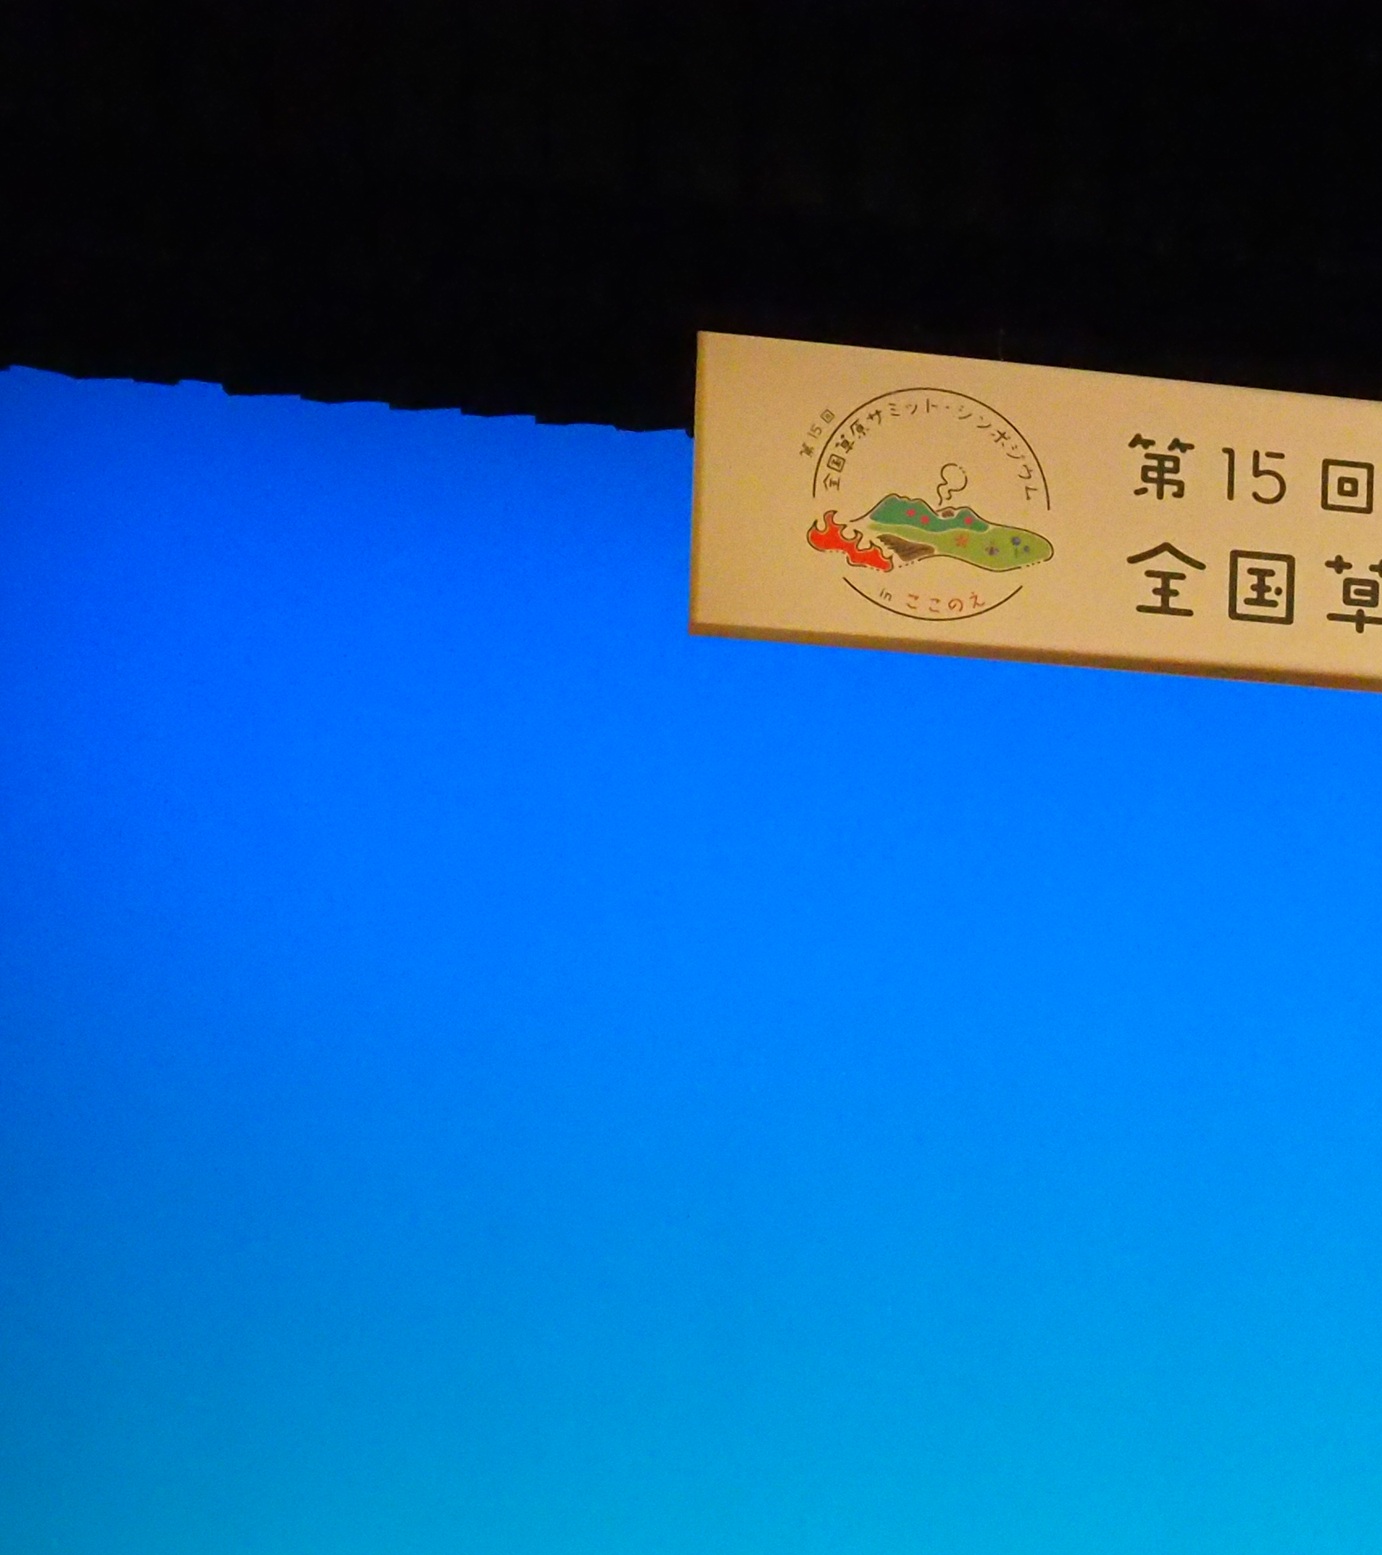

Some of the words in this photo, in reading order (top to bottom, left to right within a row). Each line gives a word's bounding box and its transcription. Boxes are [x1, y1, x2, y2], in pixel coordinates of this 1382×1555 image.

[1128, 433, 1374, 514] 第15回
[905, 591, 985, 612] ここのえ
